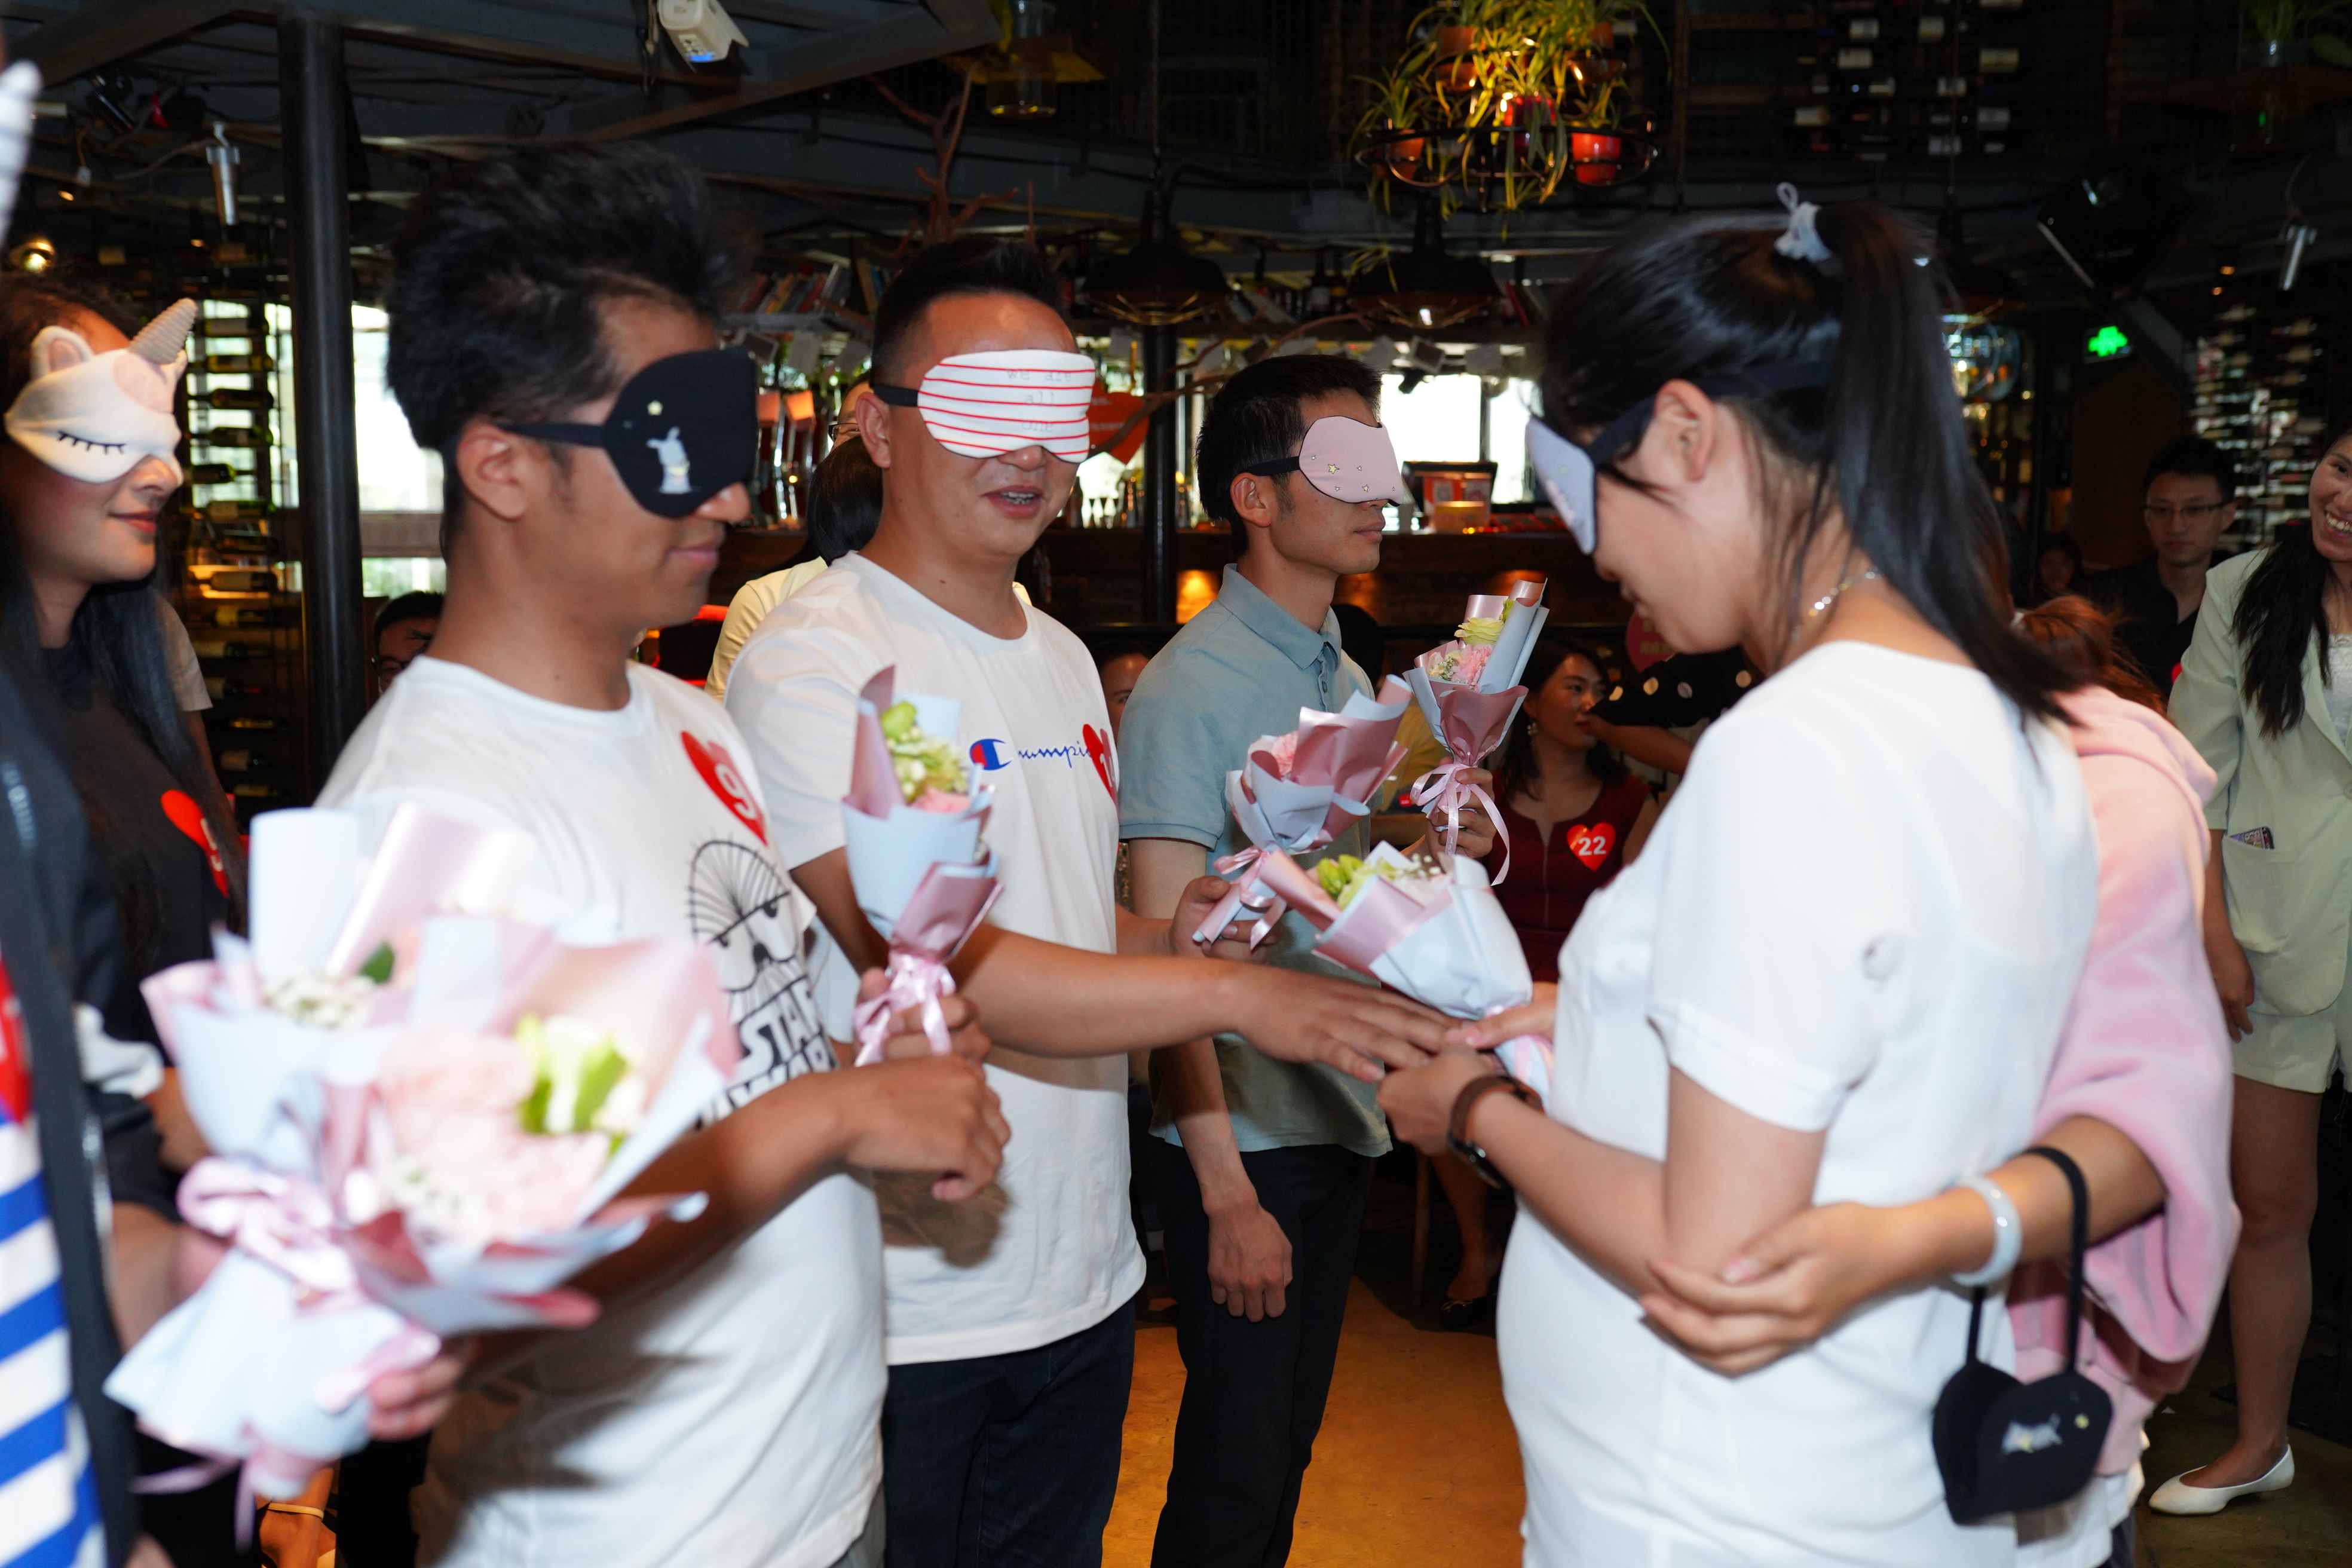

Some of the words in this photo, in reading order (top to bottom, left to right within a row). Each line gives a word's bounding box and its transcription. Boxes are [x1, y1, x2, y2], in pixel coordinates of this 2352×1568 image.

[1006, 369, 1031, 381] we
[1044, 371, 1072, 383] are
[1025, 390, 1055, 408] all
[1021, 420, 1055, 433] one
[714, 763, 756, 820] 9
[1578, 835, 1607, 856] 22
